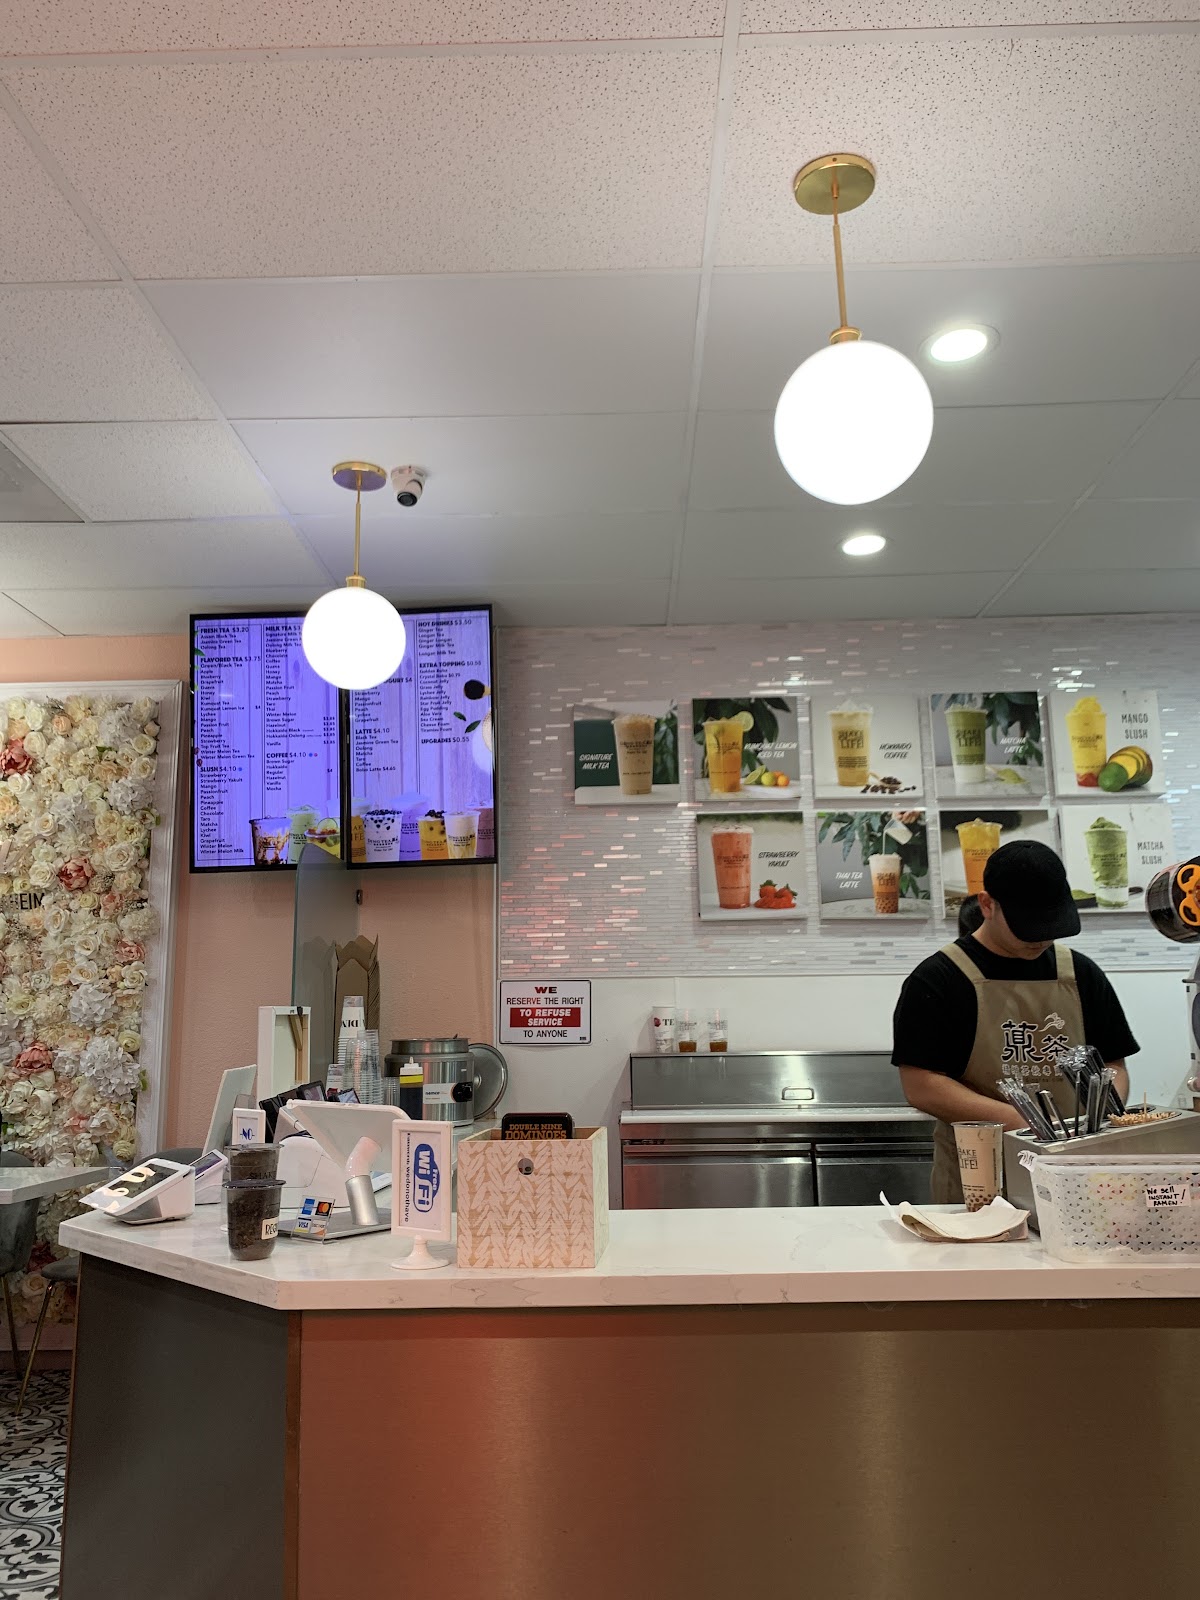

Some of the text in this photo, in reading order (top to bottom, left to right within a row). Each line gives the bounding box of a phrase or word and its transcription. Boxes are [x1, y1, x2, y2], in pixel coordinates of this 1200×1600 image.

[1122, 713, 1148, 724] MANGO
[1125, 729, 1148, 739] SLUSH
[1137, 842, 1163, 850] MATCHA
[1142, 856, 1162, 864] SLUSH
[505, 1130, 567, 1139] DOMINOES
